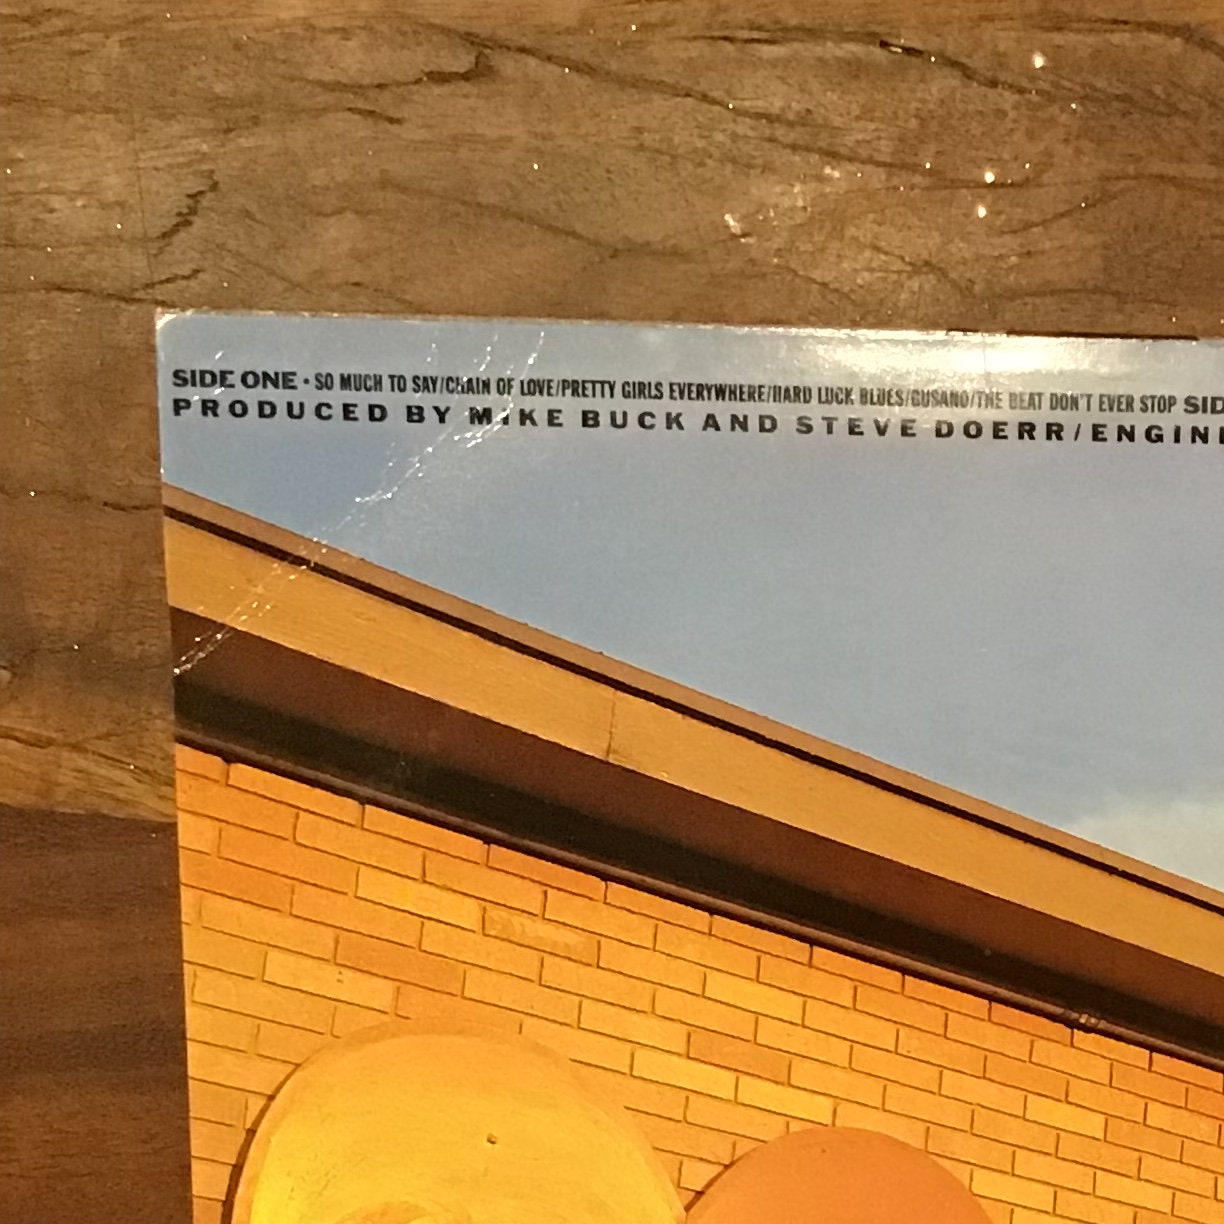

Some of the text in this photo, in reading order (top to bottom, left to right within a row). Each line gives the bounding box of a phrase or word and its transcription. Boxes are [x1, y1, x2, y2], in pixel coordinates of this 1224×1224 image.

[172, 369, 235, 388] SIDE
[240, 370, 298, 390] ONE
[314, 372, 334, 391] SO
[340, 373, 383, 393] MUCH
[388, 374, 406, 393] TO
[496, 377, 514, 396] OF
[621, 381, 664, 400] GIRLS
[817, 386, 854, 406] LUCK
[1008, 391, 1044, 411] BEAT
[1049, 392, 1093, 412] DON'T
[1098, 393, 1135, 413] EVER
[1140, 394, 1177, 414] STOP
[172, 398, 388, 422] PRODUCED
[406, 404, 451, 424] BY
[469, 406, 564, 427] MIKE
[581, 409, 685, 431] BUCK
[702, 413, 778, 433] AND
[796, 416, 917, 437] STEVE
